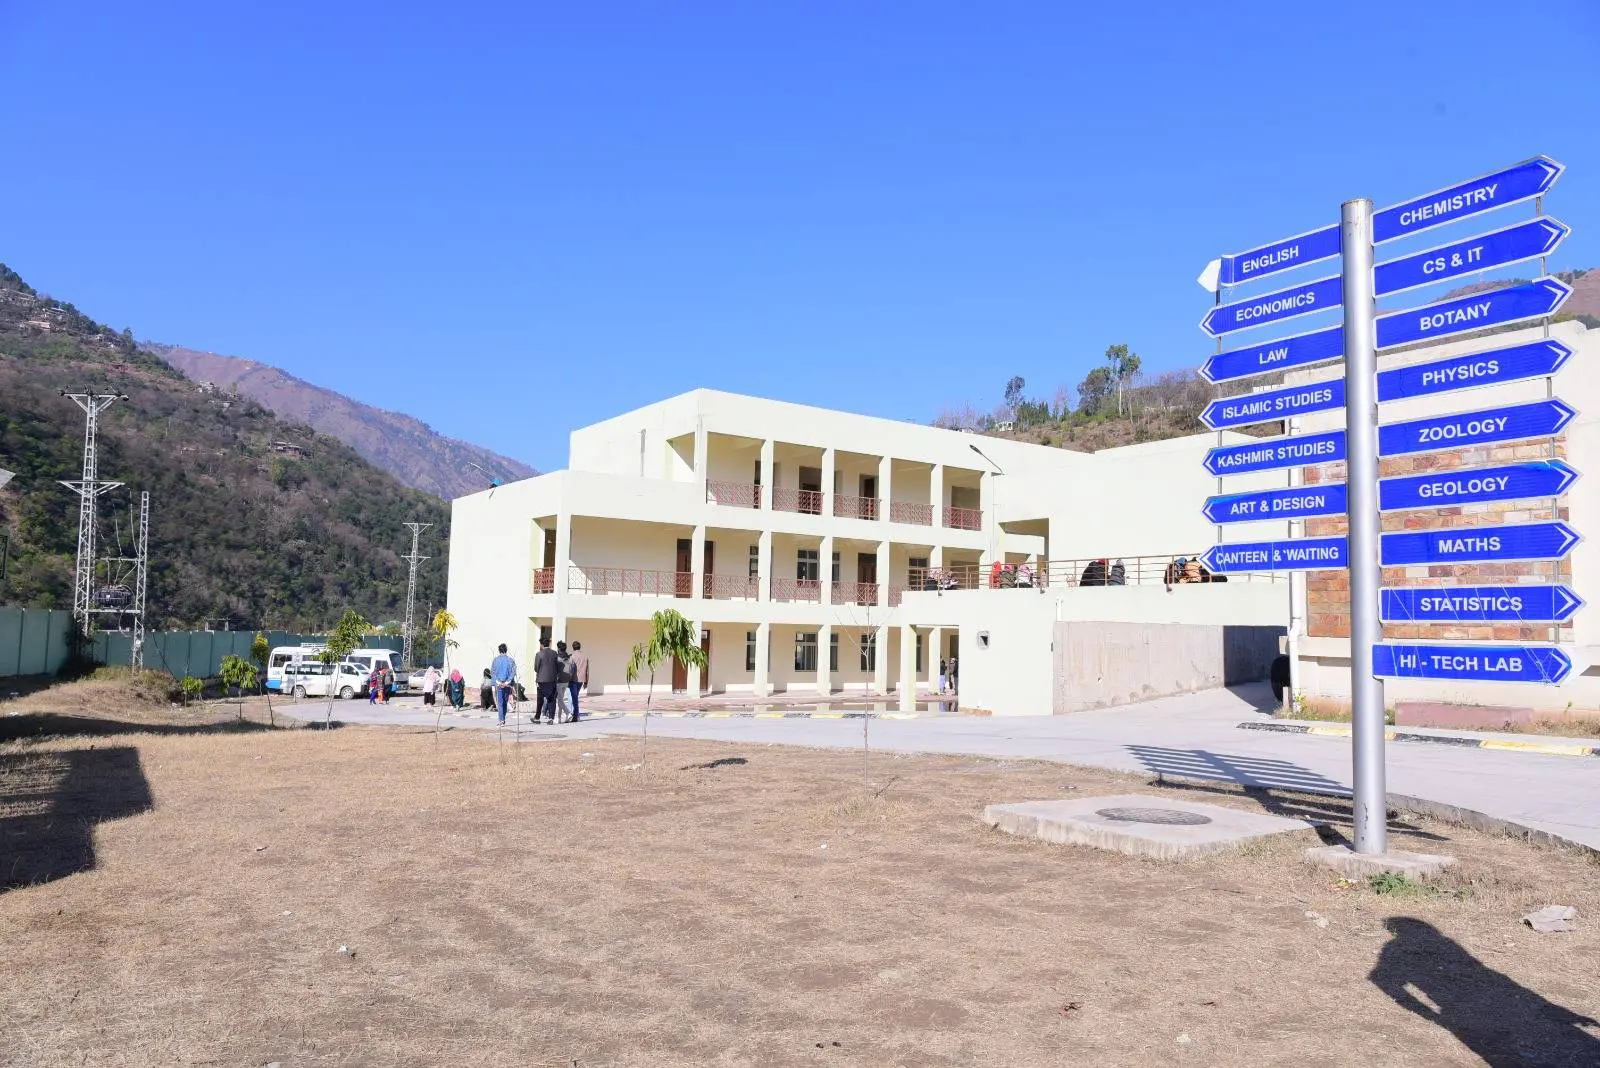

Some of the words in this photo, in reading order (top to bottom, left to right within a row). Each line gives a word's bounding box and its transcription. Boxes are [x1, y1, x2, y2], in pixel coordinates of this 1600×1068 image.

[1400, 184, 1497, 225] CHEMISTRY
[1243, 246, 1298, 273] ENGLISH
[1423, 258, 1445, 273] CS
[1451, 254, 1462, 266] &
[1468, 247, 1483, 262] IT
[1236, 292, 1314, 321] ECONOMICS
[1420, 302, 1491, 330] BOTANY
[1260, 348, 1288, 364] LAW
[1423, 361, 1498, 385] PHYSICS
[1223, 400, 1271, 419] ISLAMIC
[1276, 389, 1331, 409] STUDIES
[1419, 417, 1507, 442] ZOOLOGY
[1218, 449, 1273, 467] KASHMIR
[1278, 441, 1335, 459] STUDIES
[1419, 476, 1508, 497] GEOLOGY
[1231, 502, 1256, 514] ART
[1260, 501, 1269, 512] &
[1273, 496, 1324, 511] DESIGN
[1216, 551, 1268, 564] CANTEEN
[1273, 550, 1282, 562] &
[1287, 547, 1339, 561] WAITING
[1439, 537, 1500, 553] MATHS
[1421, 596, 1523, 612] STATISTICS
[1401, 655, 1416, 668] HI
[1431, 656, 1478, 670] TECH
[1485, 658, 1522, 671] LAB
